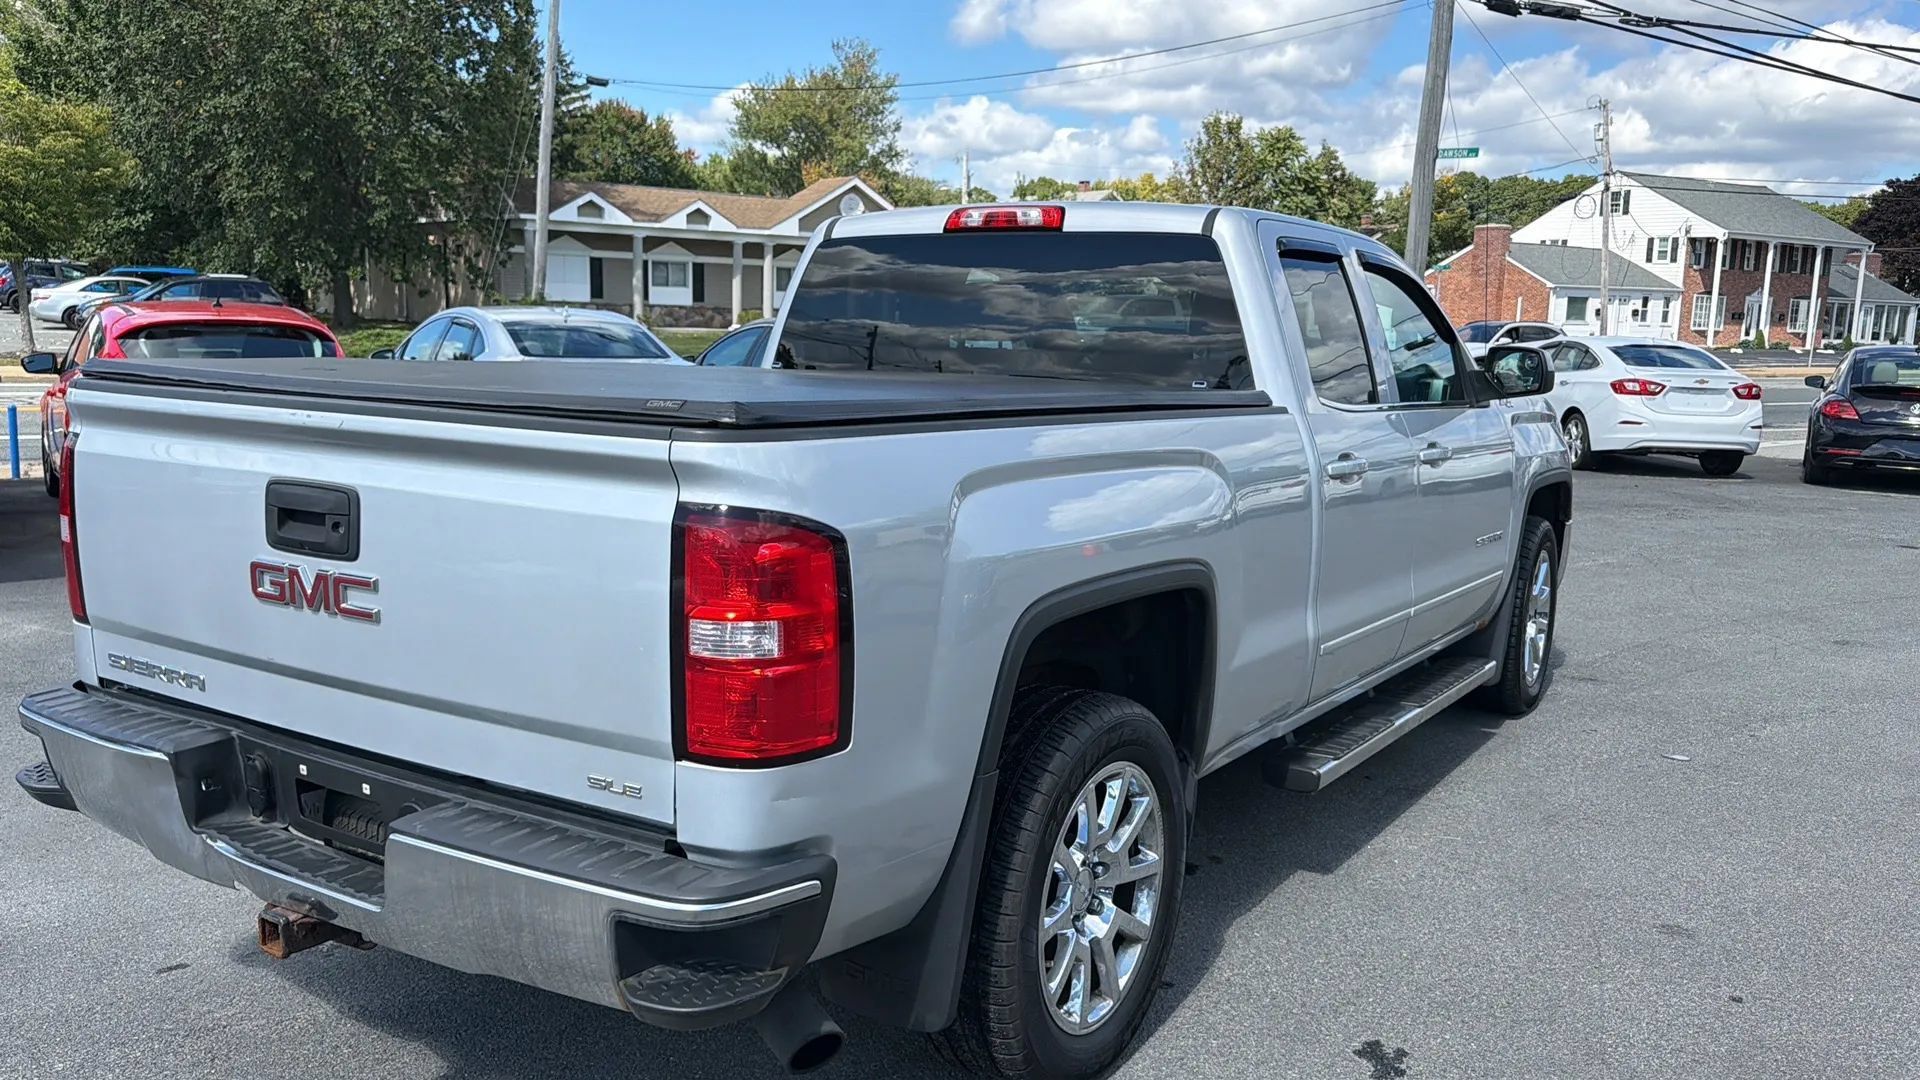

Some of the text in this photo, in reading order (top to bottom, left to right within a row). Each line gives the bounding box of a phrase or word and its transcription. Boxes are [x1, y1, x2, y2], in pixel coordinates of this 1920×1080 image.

[1439, 149, 1468, 158] DAWSON
[646, 400, 682, 408] GMC
[250, 560, 382, 625] GMC
[108, 653, 206, 693] SIERRA
[587, 775, 643, 800] SLE
